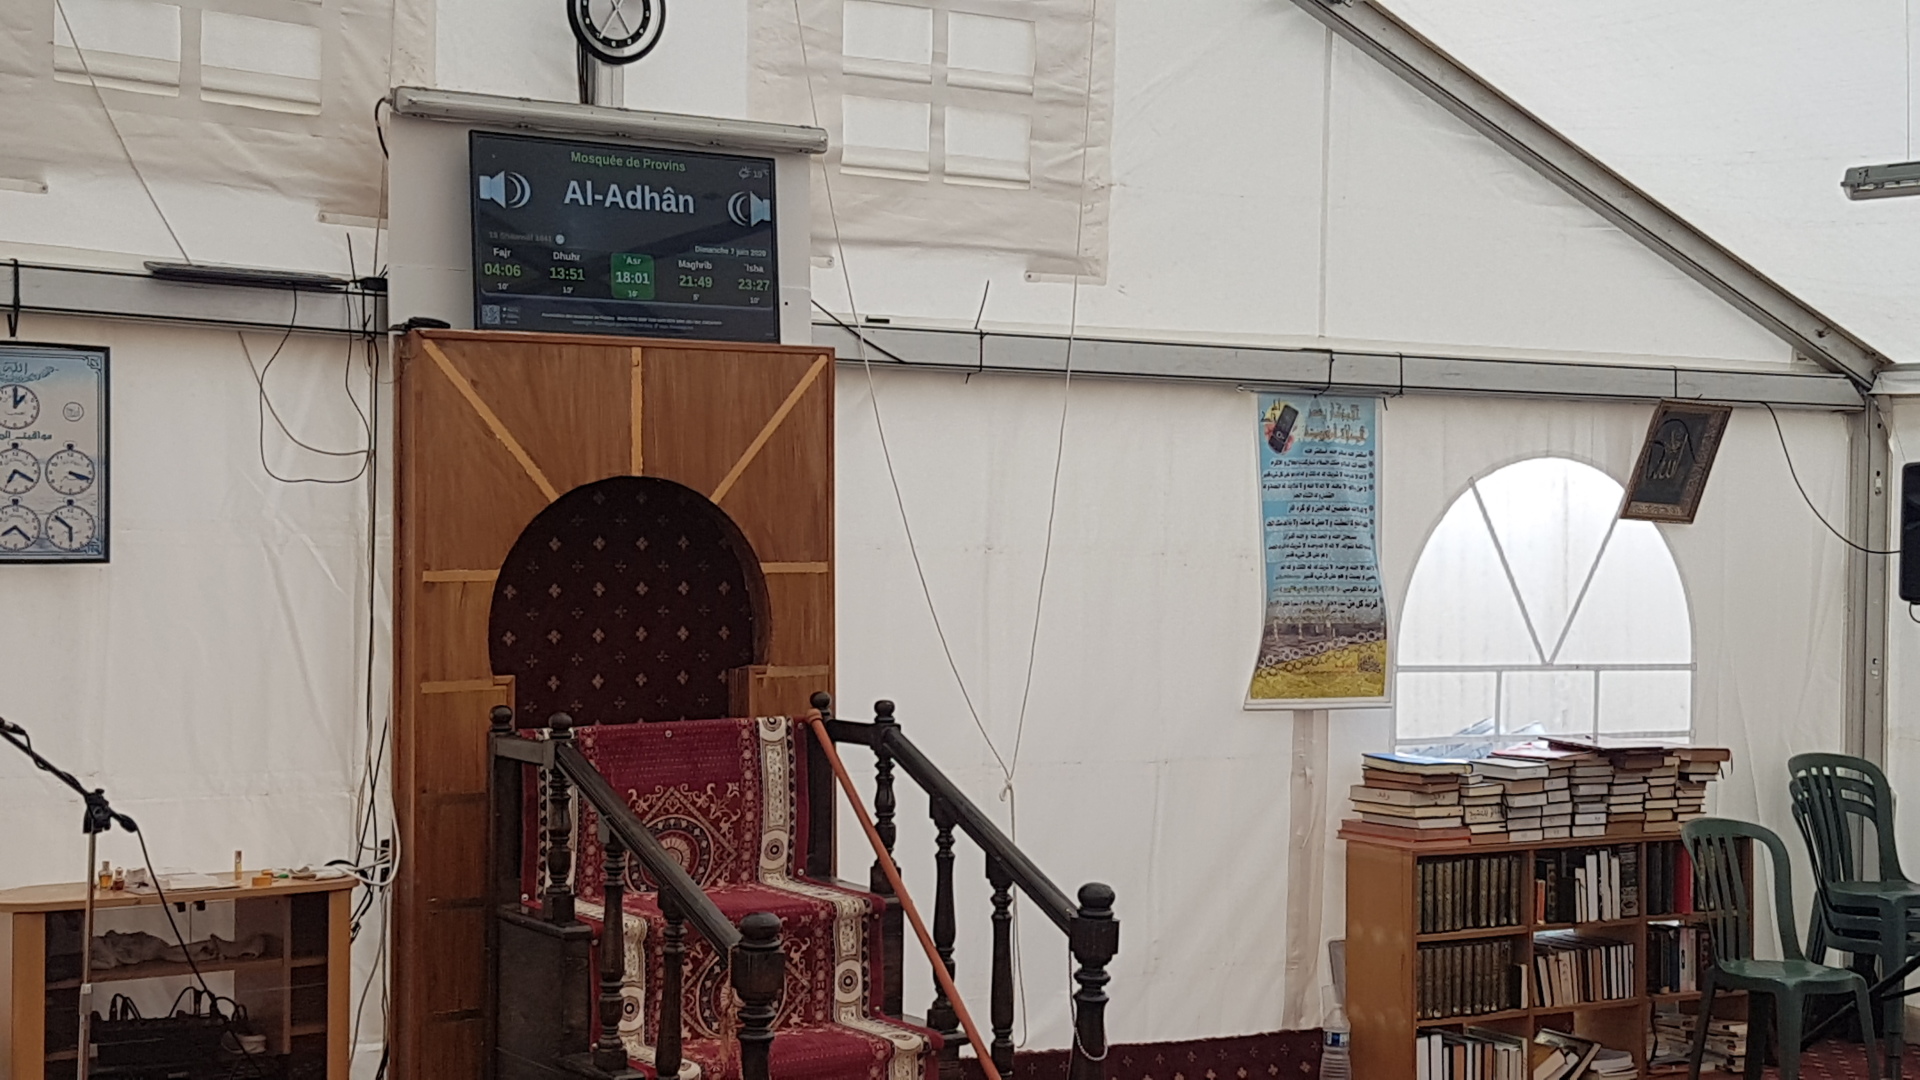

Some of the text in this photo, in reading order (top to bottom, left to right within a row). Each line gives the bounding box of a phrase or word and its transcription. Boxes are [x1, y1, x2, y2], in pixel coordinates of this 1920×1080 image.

[570, 151, 686, 172] Mosquée de Provins
[563, 179, 695, 214] Al-Adhân
[493, 247, 512, 259] Fajr
[552, 251, 581, 261] Dhuhr
[694, 246, 729, 255] Dimanche
[736, 248, 749, 258] juin
[750, 250, 766, 258] 2020
[484, 262, 522, 276] 04:06
[678, 259, 712, 271] Maghrib
[550, 266, 585, 281] 13:51
[615, 271, 650, 284] 18:01
[679, 275, 713, 288] 21:49
[738, 278, 770, 291] 23:27
